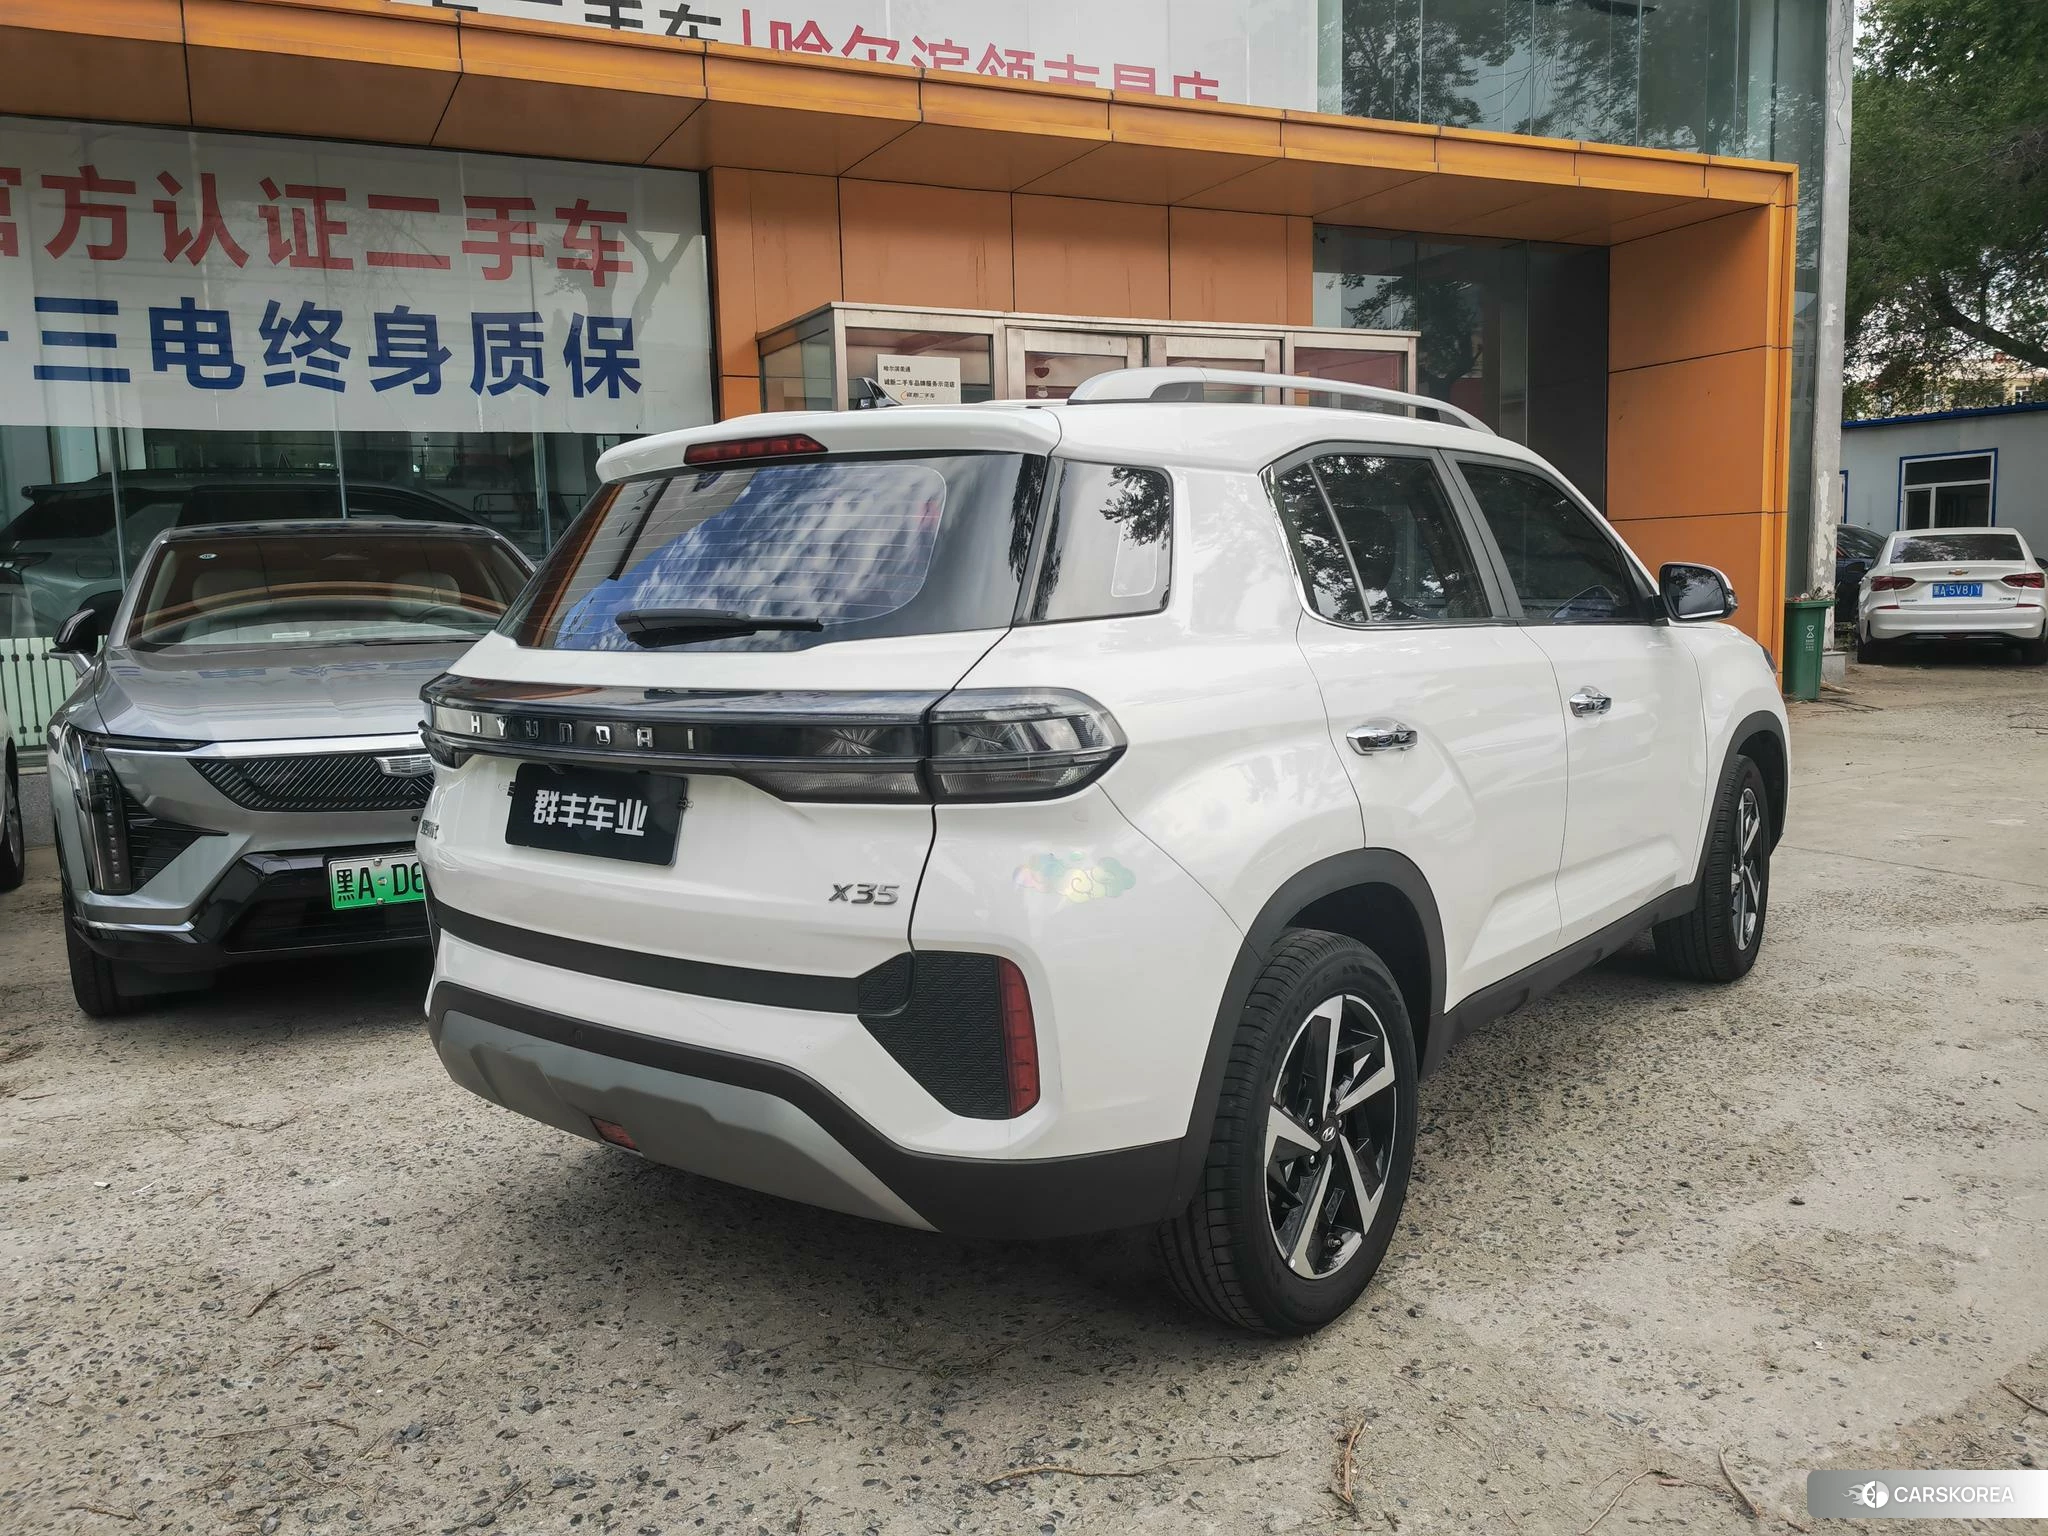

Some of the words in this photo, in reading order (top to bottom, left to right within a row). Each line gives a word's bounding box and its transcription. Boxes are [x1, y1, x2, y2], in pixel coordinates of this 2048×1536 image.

[0, 164, 634, 288] 方认证二手车
[0, 296, 643, 399] 三电终身质保
[470, 714, 695, 751] HYUNDAI
[532, 788, 649, 837] 群丰车业
